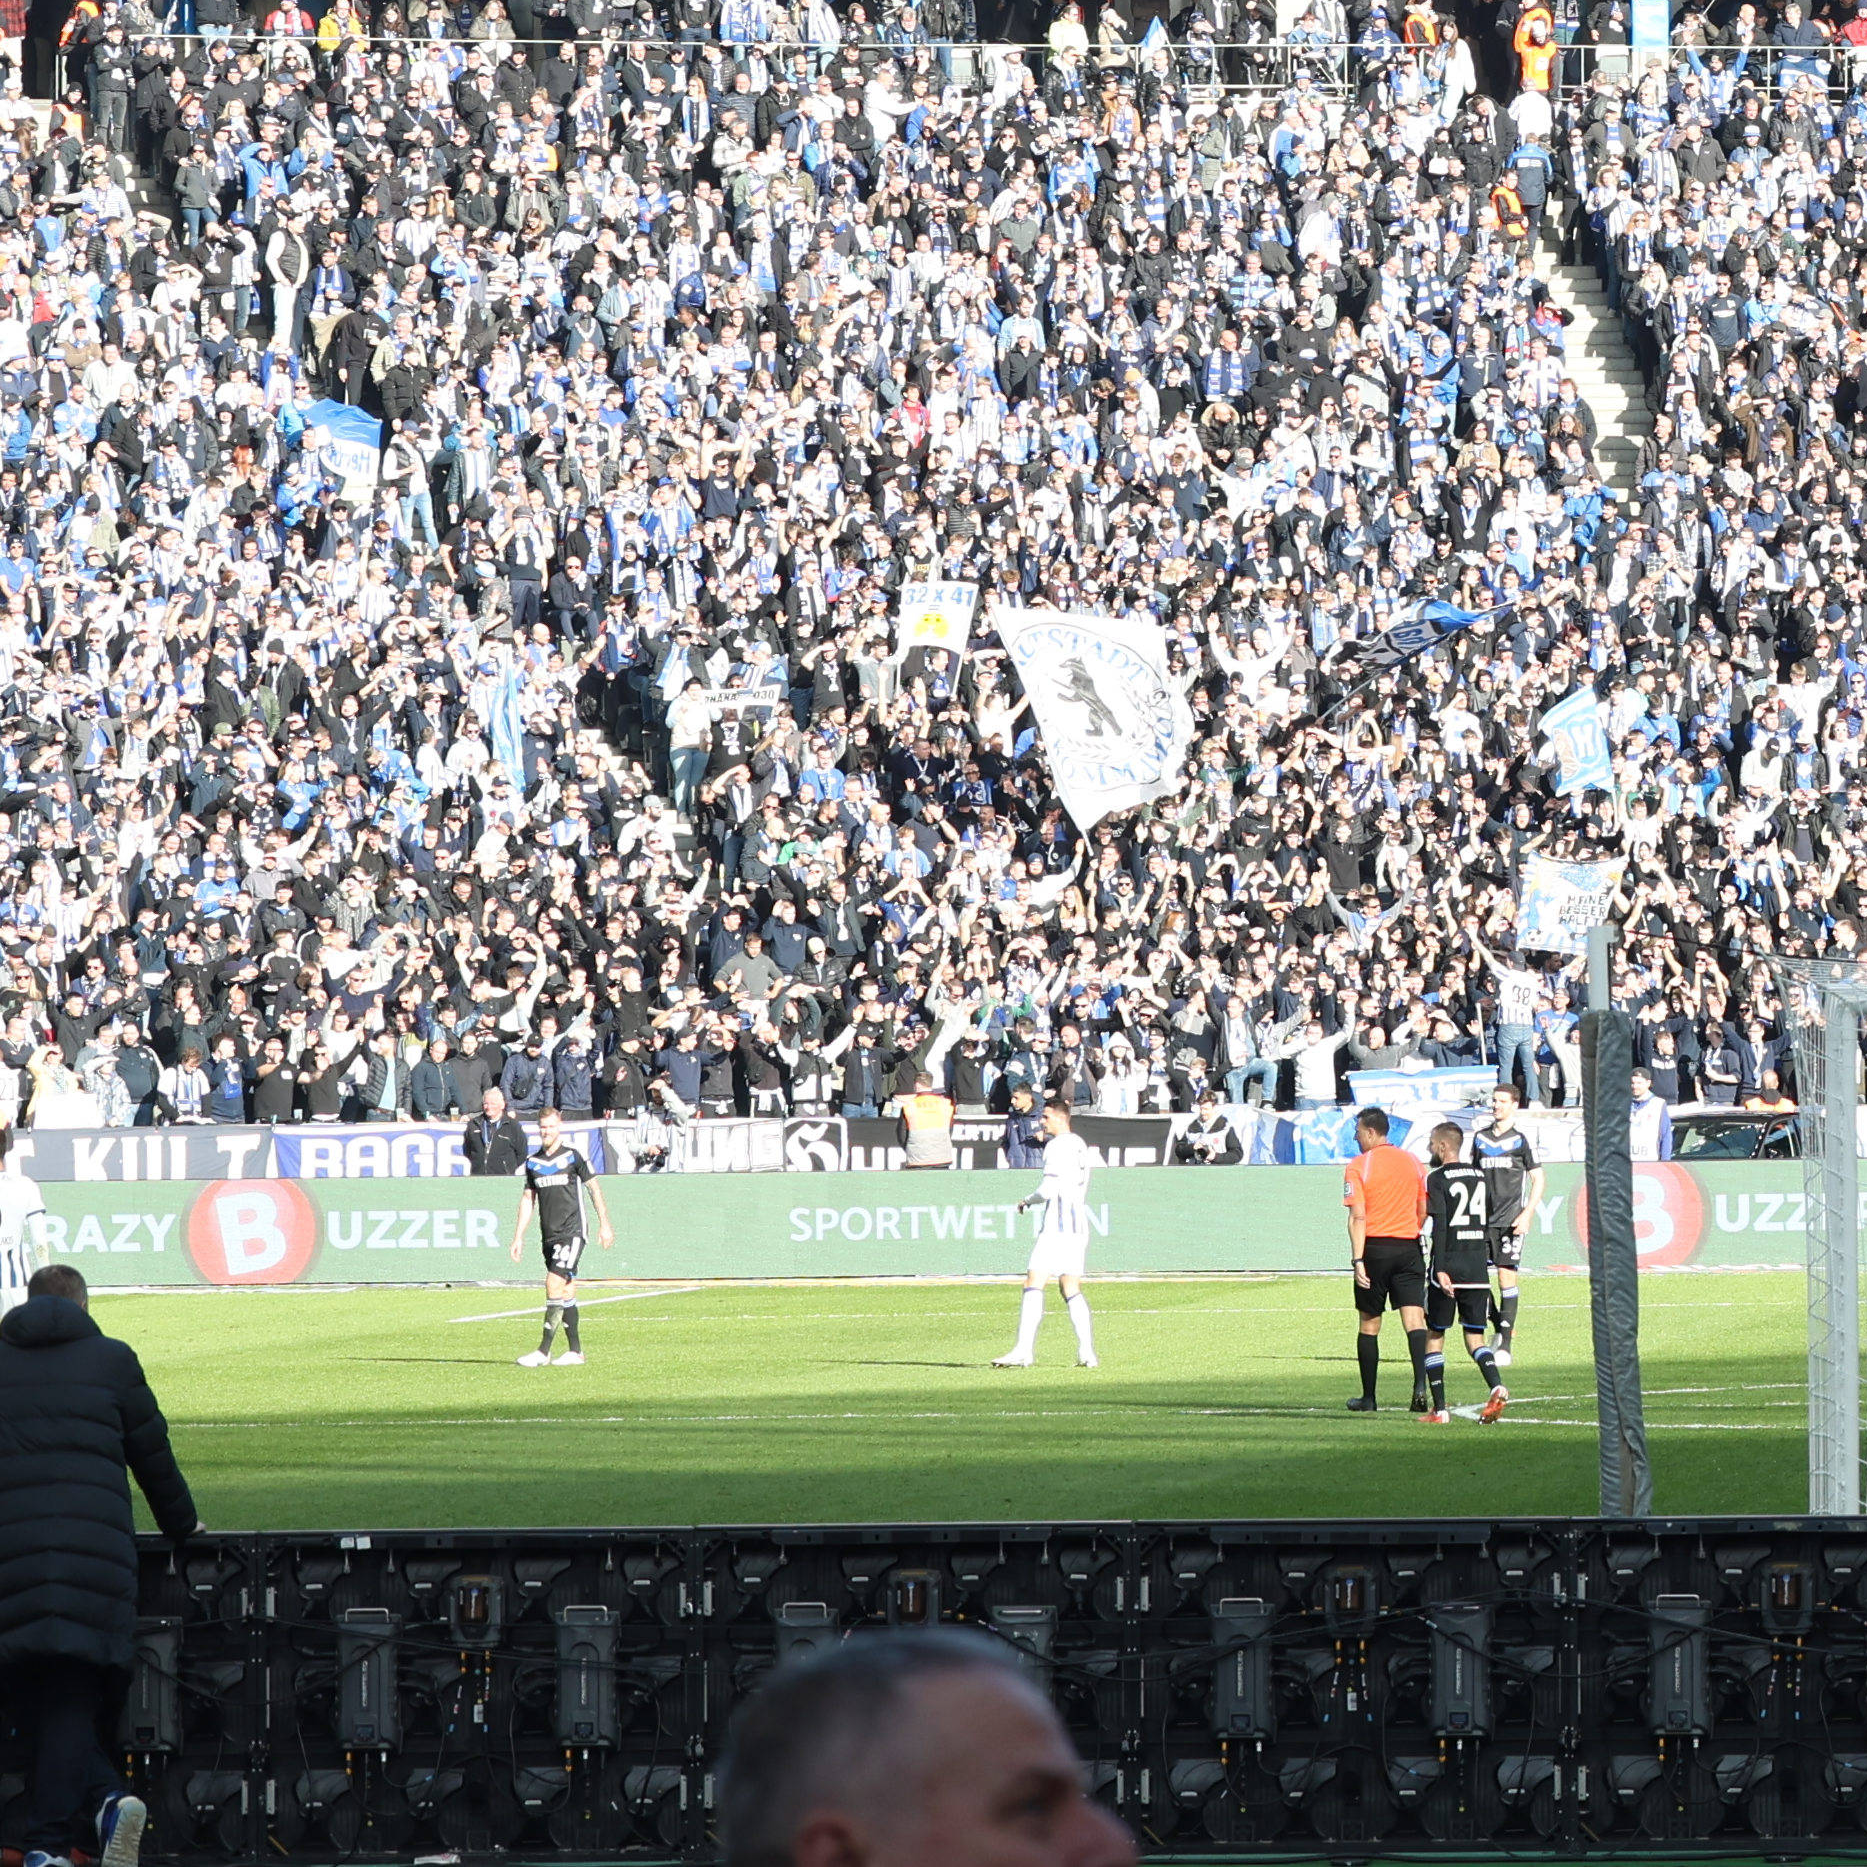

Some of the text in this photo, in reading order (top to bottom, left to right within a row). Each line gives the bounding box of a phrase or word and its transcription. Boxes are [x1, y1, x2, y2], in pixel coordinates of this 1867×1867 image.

[904, 585, 929, 606] 32
[950, 585, 976, 608] 41
[1449, 1180, 1487, 1227] 24
[45, 1213, 178, 1254] RAZY
